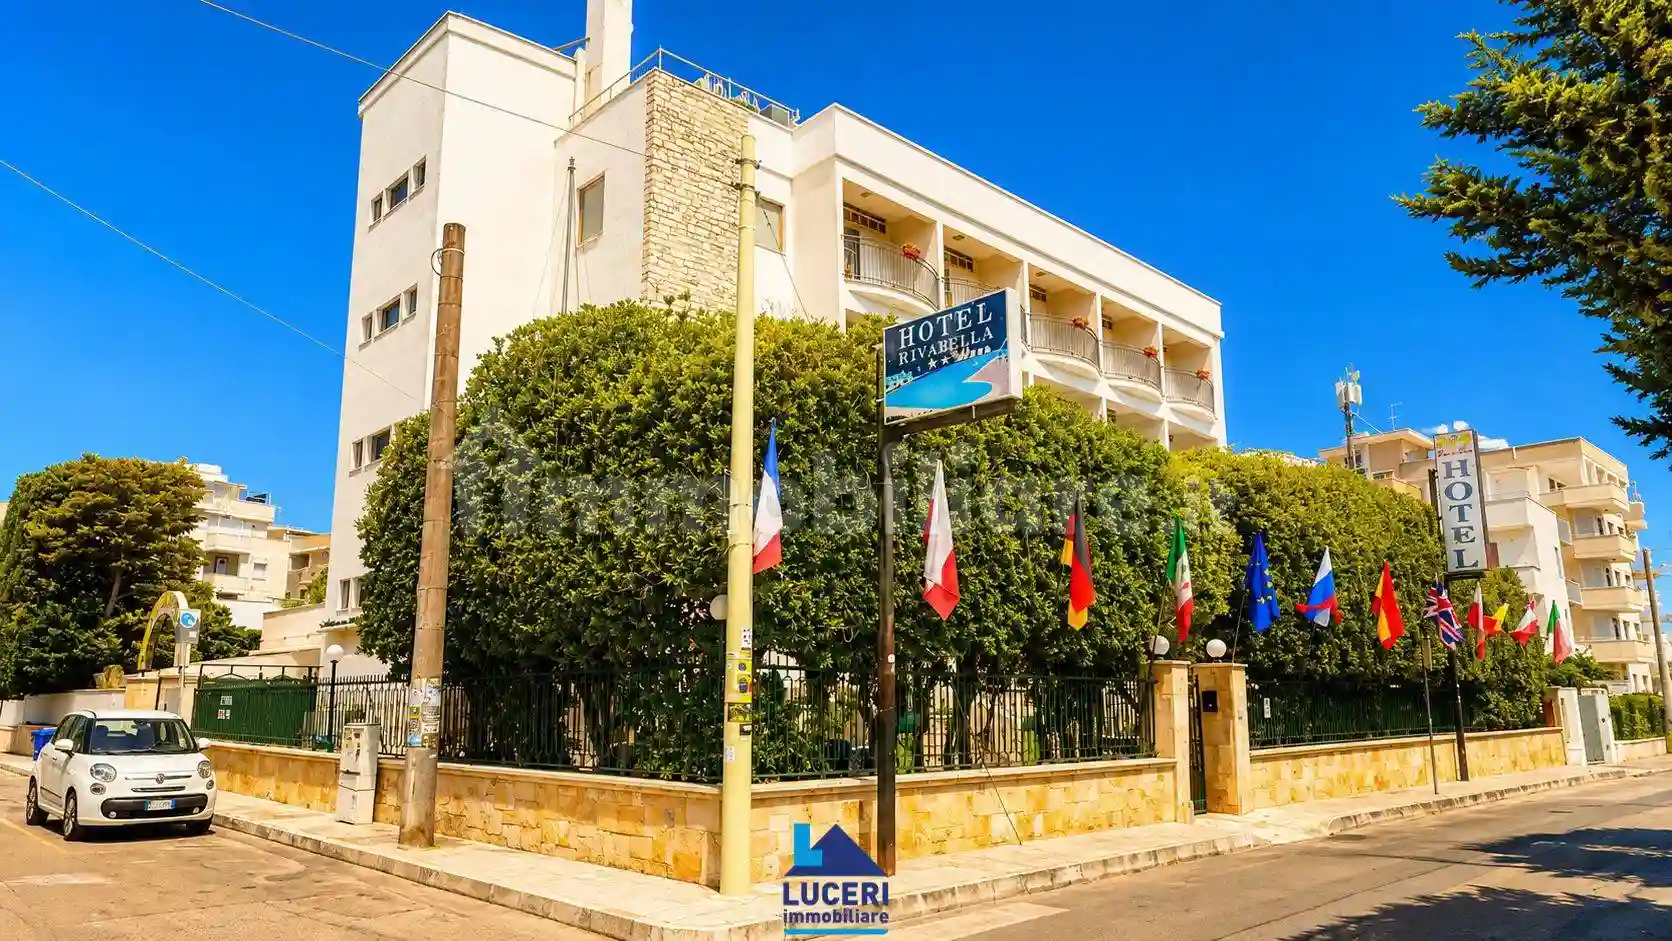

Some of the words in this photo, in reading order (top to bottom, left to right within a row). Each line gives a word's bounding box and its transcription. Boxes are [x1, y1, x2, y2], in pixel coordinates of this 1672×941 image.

[898, 302, 993, 350] HOTEL
[898, 326, 994, 366] RIVABELLA
[1441, 458, 1479, 569] HOTEL
